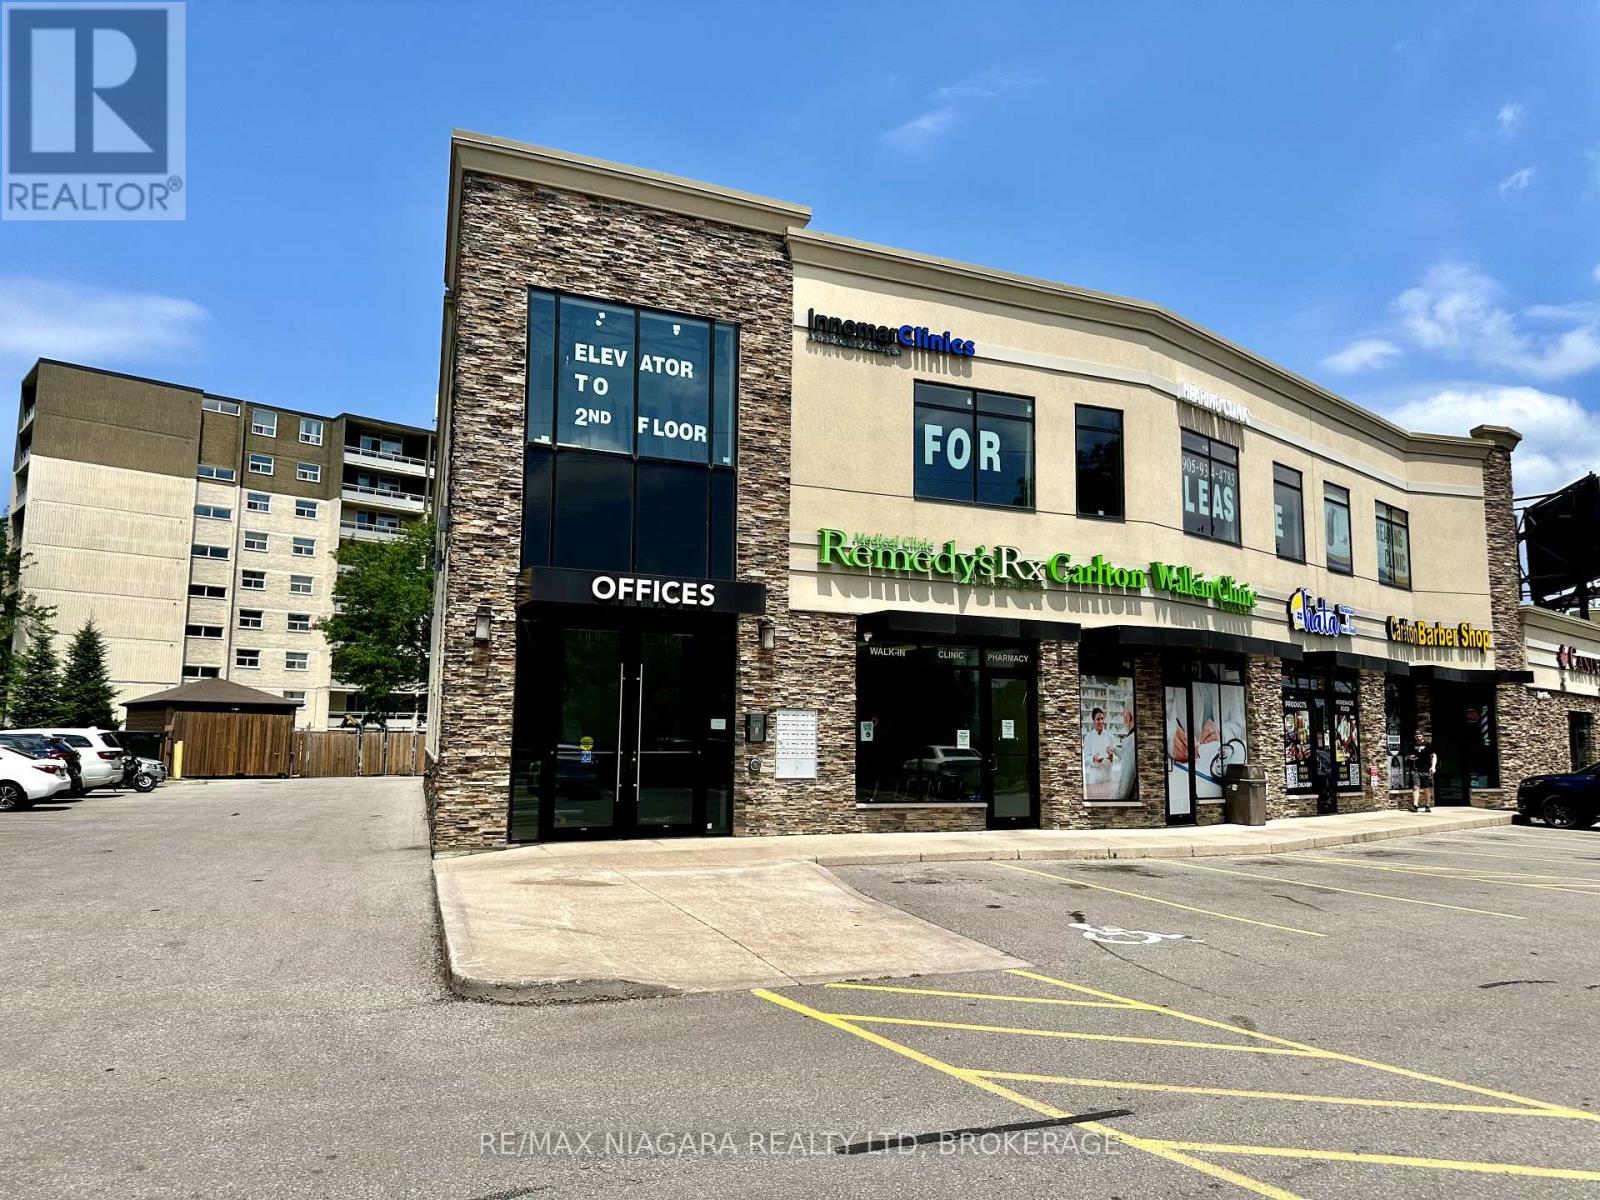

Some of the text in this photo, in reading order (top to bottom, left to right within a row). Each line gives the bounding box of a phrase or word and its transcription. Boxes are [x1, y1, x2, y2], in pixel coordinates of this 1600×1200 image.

[575, 374, 609, 396] TO
[574, 408, 707, 443] 2ND FLOOR
[925, 424, 1001, 472] FOR
[1184, 475, 1235, 522] LEAS
[592, 576, 715, 606] OFFICES
[1046, 553, 1146, 588] Carlton
[1213, 575, 1258, 607] Clinic
[870, 647, 964, 659] WALK-IN CLINIC
[1415, 621, 1459, 647] Barber
[1459, 622, 1489, 654] Shop
[987, 653, 1029, 663] PHARMACY
